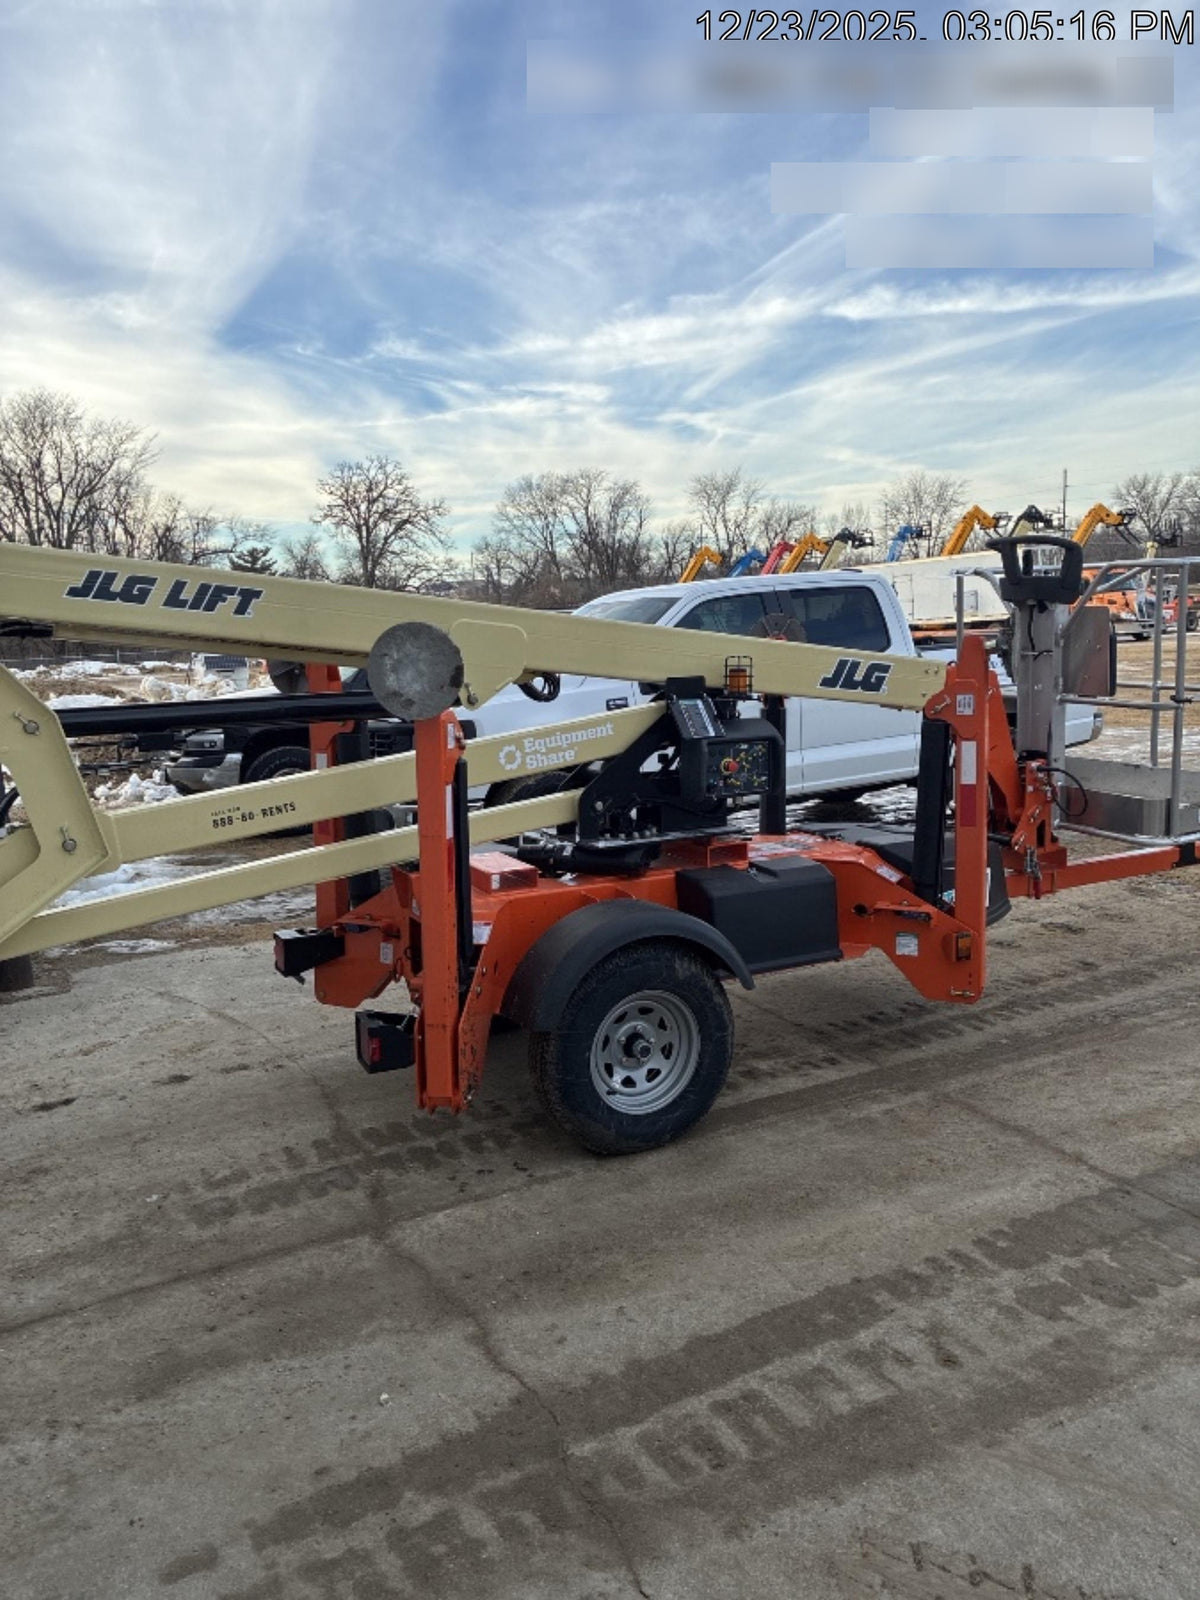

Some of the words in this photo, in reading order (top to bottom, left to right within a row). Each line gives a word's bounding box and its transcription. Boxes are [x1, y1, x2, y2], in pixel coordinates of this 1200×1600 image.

[64, 570, 159, 605] JLG
[161, 579, 264, 616] LIFT
[818, 657, 894, 693] JLG
[522, 722, 614, 752] Equipment
[525, 749, 575, 769] Share
